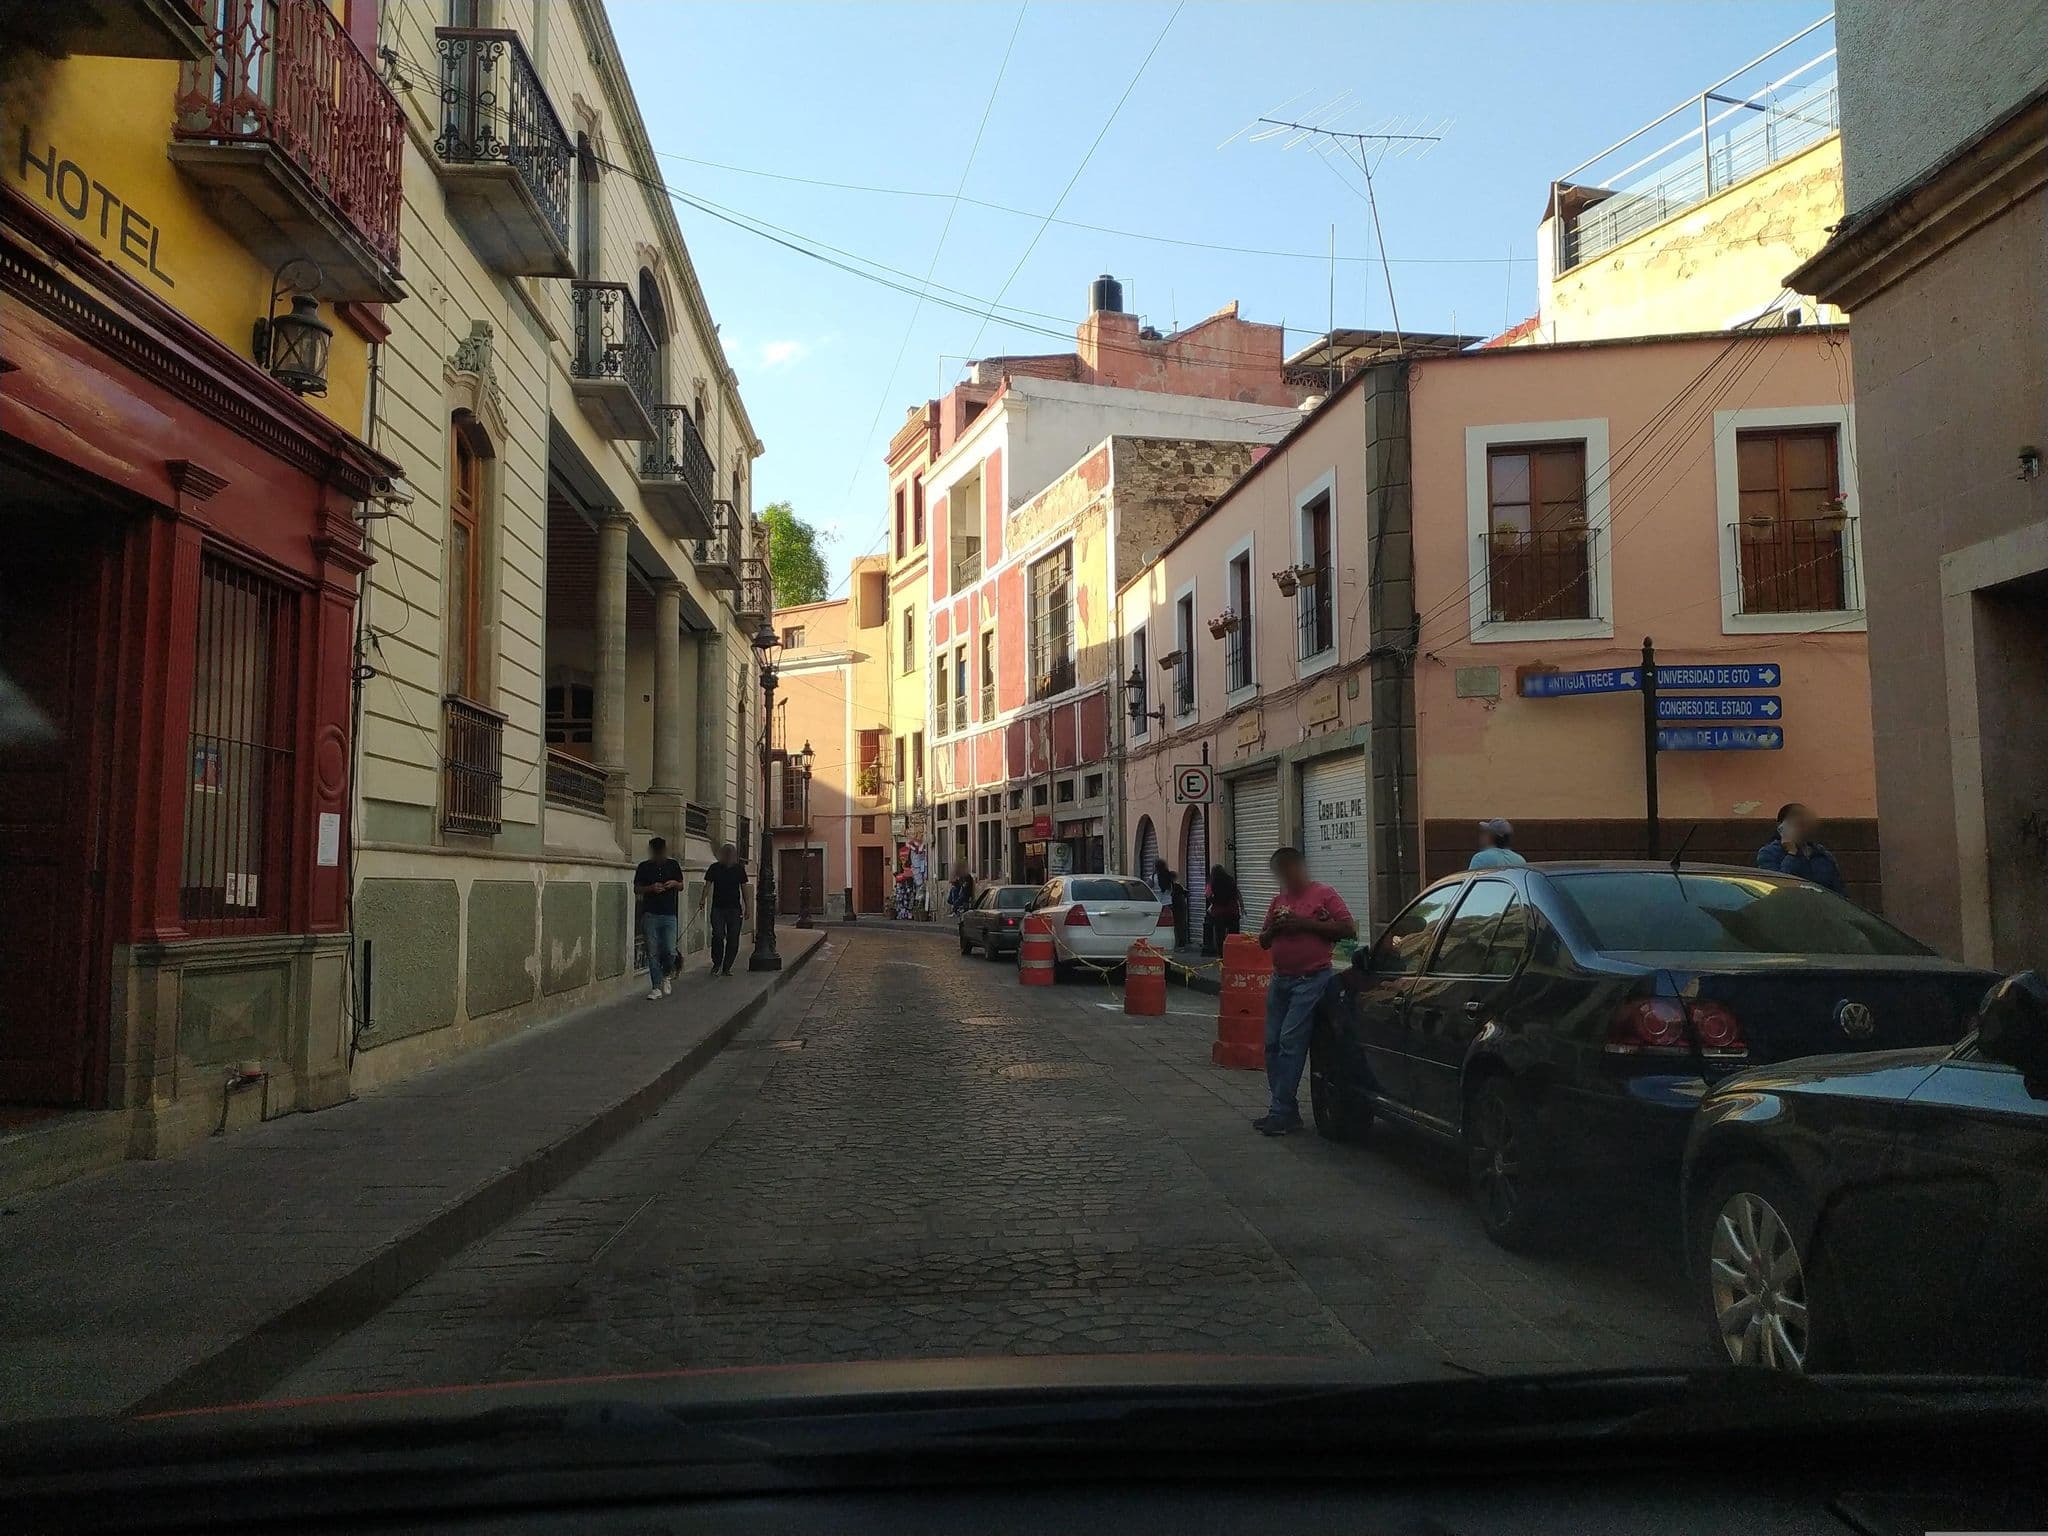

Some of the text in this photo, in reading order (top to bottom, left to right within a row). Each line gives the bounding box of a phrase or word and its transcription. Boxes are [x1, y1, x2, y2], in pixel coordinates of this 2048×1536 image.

[19, 124, 175, 289] HOTEL
[1586, 672, 1615, 688] TRECE
[1657, 668, 1751, 685] UNIVERSIDAD DE GTO
[1659, 700, 1753, 716] CONGRESO DEL ESTADO
[1186, 775, 1201, 793] E
